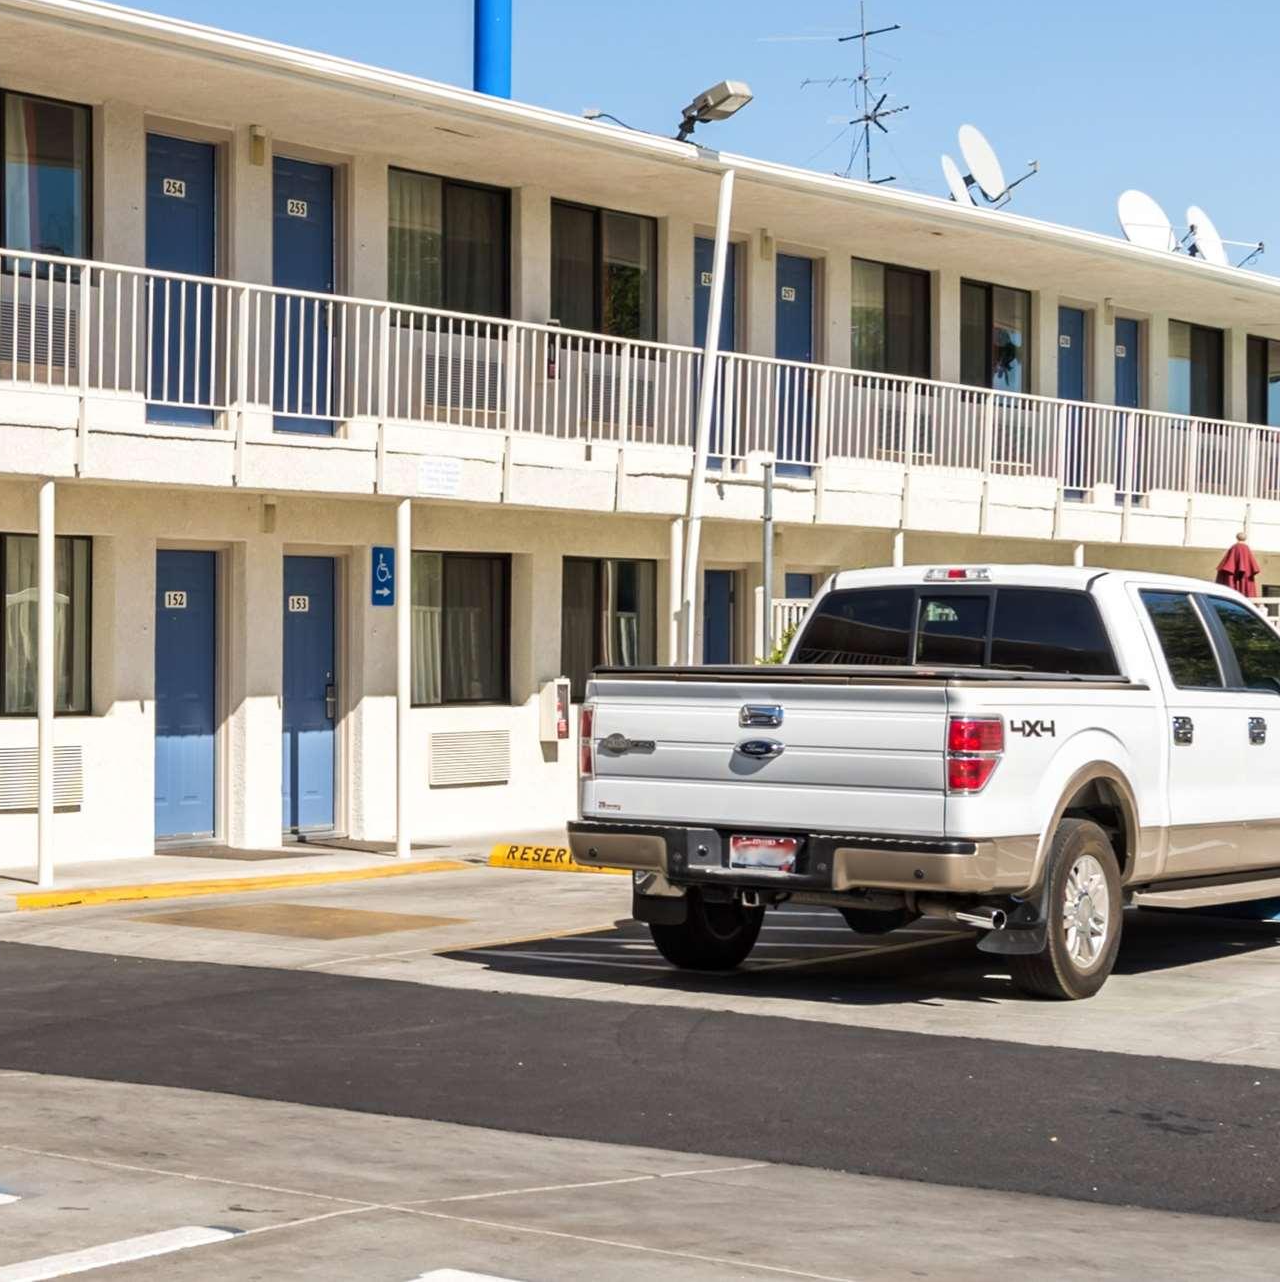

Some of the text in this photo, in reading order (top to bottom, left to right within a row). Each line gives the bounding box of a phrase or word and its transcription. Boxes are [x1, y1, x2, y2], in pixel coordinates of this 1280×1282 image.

[165, 180, 183, 195] 254
[289, 201, 306, 215] 255
[167, 593, 184, 606] 152
[291, 597, 307, 610] 153
